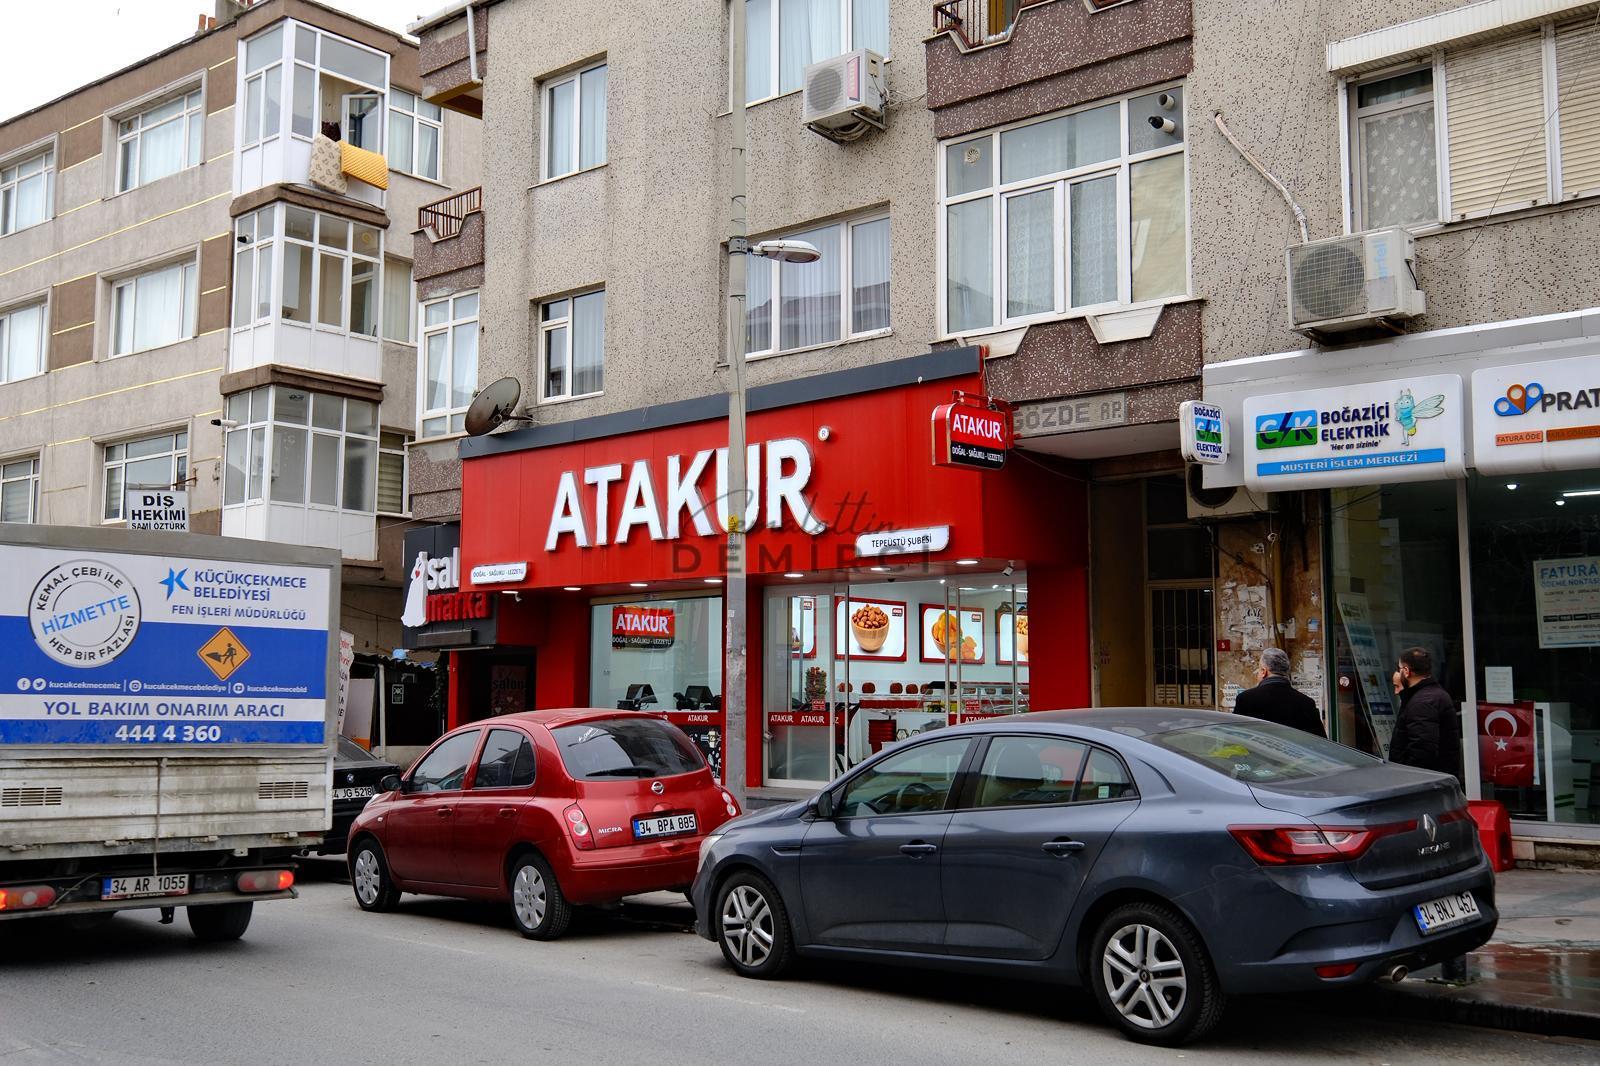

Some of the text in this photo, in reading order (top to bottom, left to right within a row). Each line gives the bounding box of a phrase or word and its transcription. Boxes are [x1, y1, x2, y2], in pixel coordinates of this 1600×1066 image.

[1320, 402, 1390, 425] BOĞAZİÇİ
[953, 412, 1003, 442] ATAKUR
[1321, 423, 1391, 443] ELEKTRİK
[1497, 434, 1524, 443] FATURA
[1366, 452, 1419, 466] MERKEZİ
[143, 493, 175, 508] DİŞ
[544, 438, 827, 552] ATAKUR
[132, 507, 186, 521] HEKİMİ
[153, 521, 186, 530] ÖZTÜRK
[872, 533, 932, 548] TEPEÜSTÜ ŞUBESİ
[194, 570, 307, 589] KÜÇÜKÇEKMECE
[1541, 564, 1599, 580] FATURA
[36, 573, 69, 610] KEMAL
[71, 566, 102, 578] ÇEBİ
[193, 586, 270, 601] BELEDİYESİ
[41, 595, 130, 635] HİZMETTE
[172, 604, 306, 621] FEN İŞLERİ MÜDÜRLÜĞÜ
[615, 613, 670, 634] ATAKUR
[48, 615, 135, 660] HEP BİR FAZLASI
[43, 701, 285, 718] YOL BAKIM ONARIM ARACI
[687, 714, 709, 723] ATAKUR
[770, 714, 794, 723] ATAKUR
[800, 715, 825, 724] ATAKUR
[114, 725, 222, 741] 444 4 360
[354, 787, 372, 797] 5218
[598, 826, 623, 834] MICRA
[640, 822, 651, 834] 34
[657, 818, 675, 832] BPA
[677, 816, 695, 829] 885
[112, 876, 186, 893] 34 AR 1055
